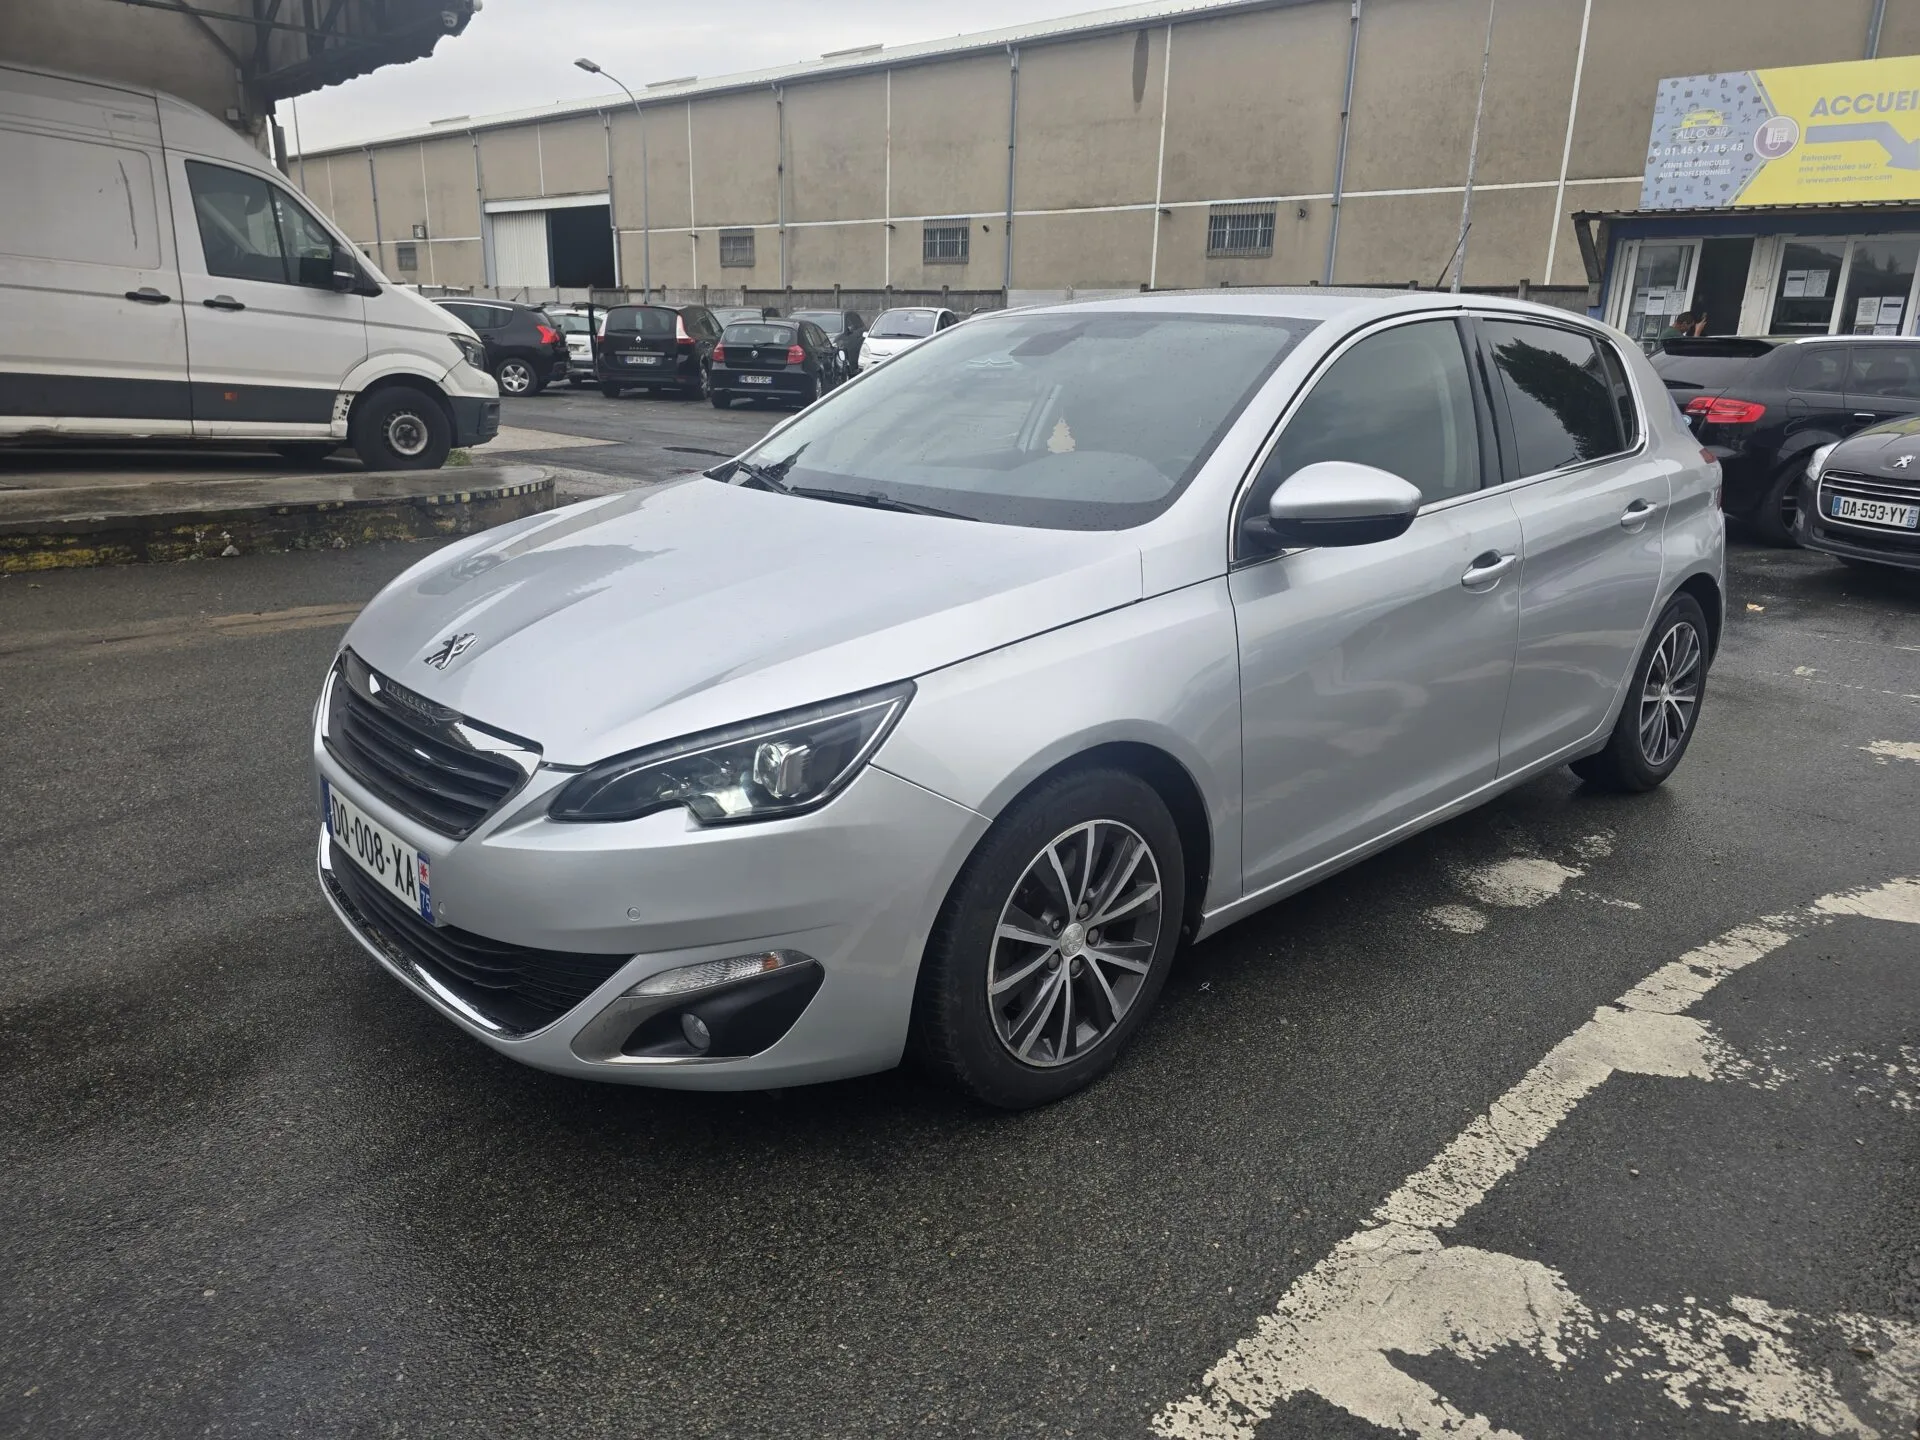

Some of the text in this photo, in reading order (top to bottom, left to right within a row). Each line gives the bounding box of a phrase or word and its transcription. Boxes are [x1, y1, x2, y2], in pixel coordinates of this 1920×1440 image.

[1842, 500, 1907, 523] DA-593-YY
[331, 794, 417, 902] DQ-008-XA
[420, 890, 431, 913] 75
